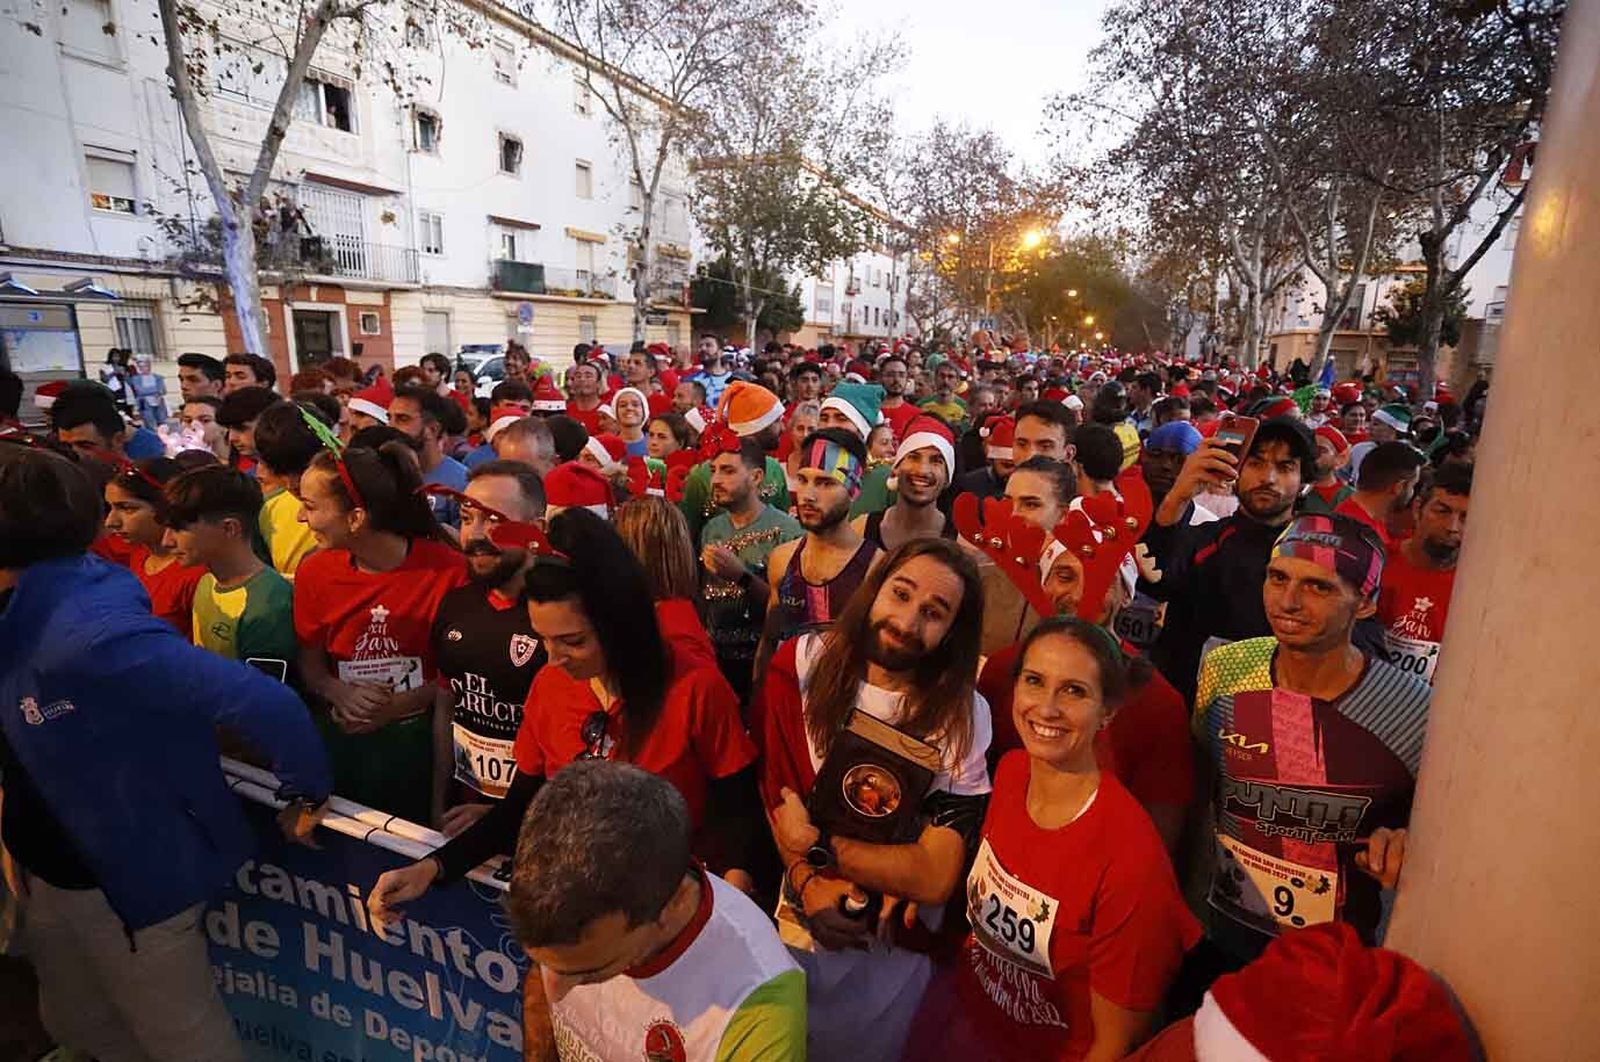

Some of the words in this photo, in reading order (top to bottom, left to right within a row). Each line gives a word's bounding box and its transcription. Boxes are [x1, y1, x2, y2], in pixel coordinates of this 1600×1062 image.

[1391, 651, 1428, 674] 200
[464, 672, 496, 698] EL
[476, 754, 519, 783] 107
[1274, 886, 1294, 916] 9
[986, 893, 1035, 954] 259
[205, 901, 281, 957] de
[303, 922, 524, 1051] Huelva
[310, 992, 352, 1028] de
